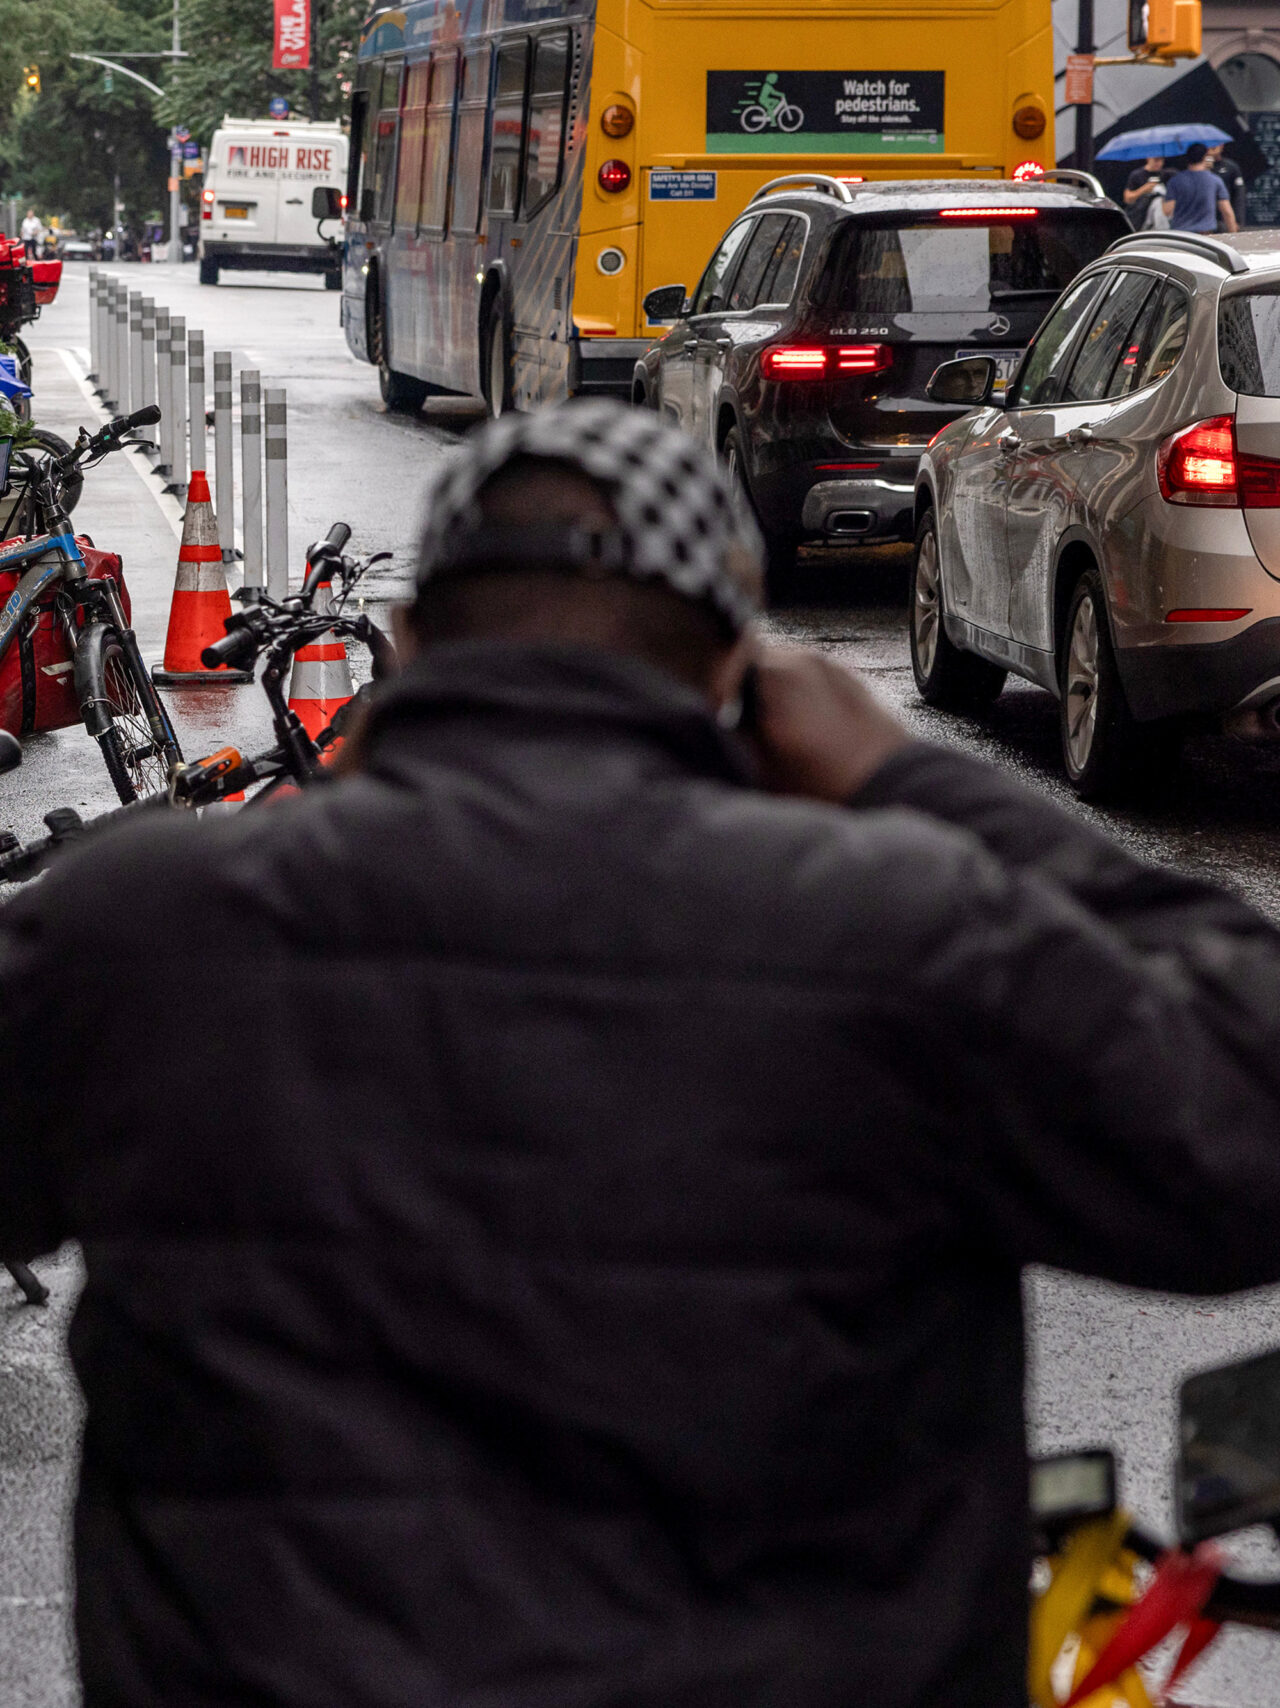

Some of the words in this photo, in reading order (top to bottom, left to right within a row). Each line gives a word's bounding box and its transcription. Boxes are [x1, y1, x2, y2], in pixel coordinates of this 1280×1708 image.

[280, 15, 295, 50] THE
[292, 0, 306, 50] VILLA
[843, 79, 886, 95] Watch
[888, 79, 910, 95] for
[835, 97, 920, 115] pedestrians.
[841, 115, 857, 125] Stay
[858, 115, 868, 123] off
[869, 115, 880, 123] the
[881, 115, 912, 124] sidewalk.
[250, 146, 288, 168] HIGH
[296, 148, 332, 171] RISE
[227, 169, 248, 178] FIRE
[691, 182, 713, 190] Doing?
[829, 328, 858, 336] GLB
[860, 327, 889, 336] 250
